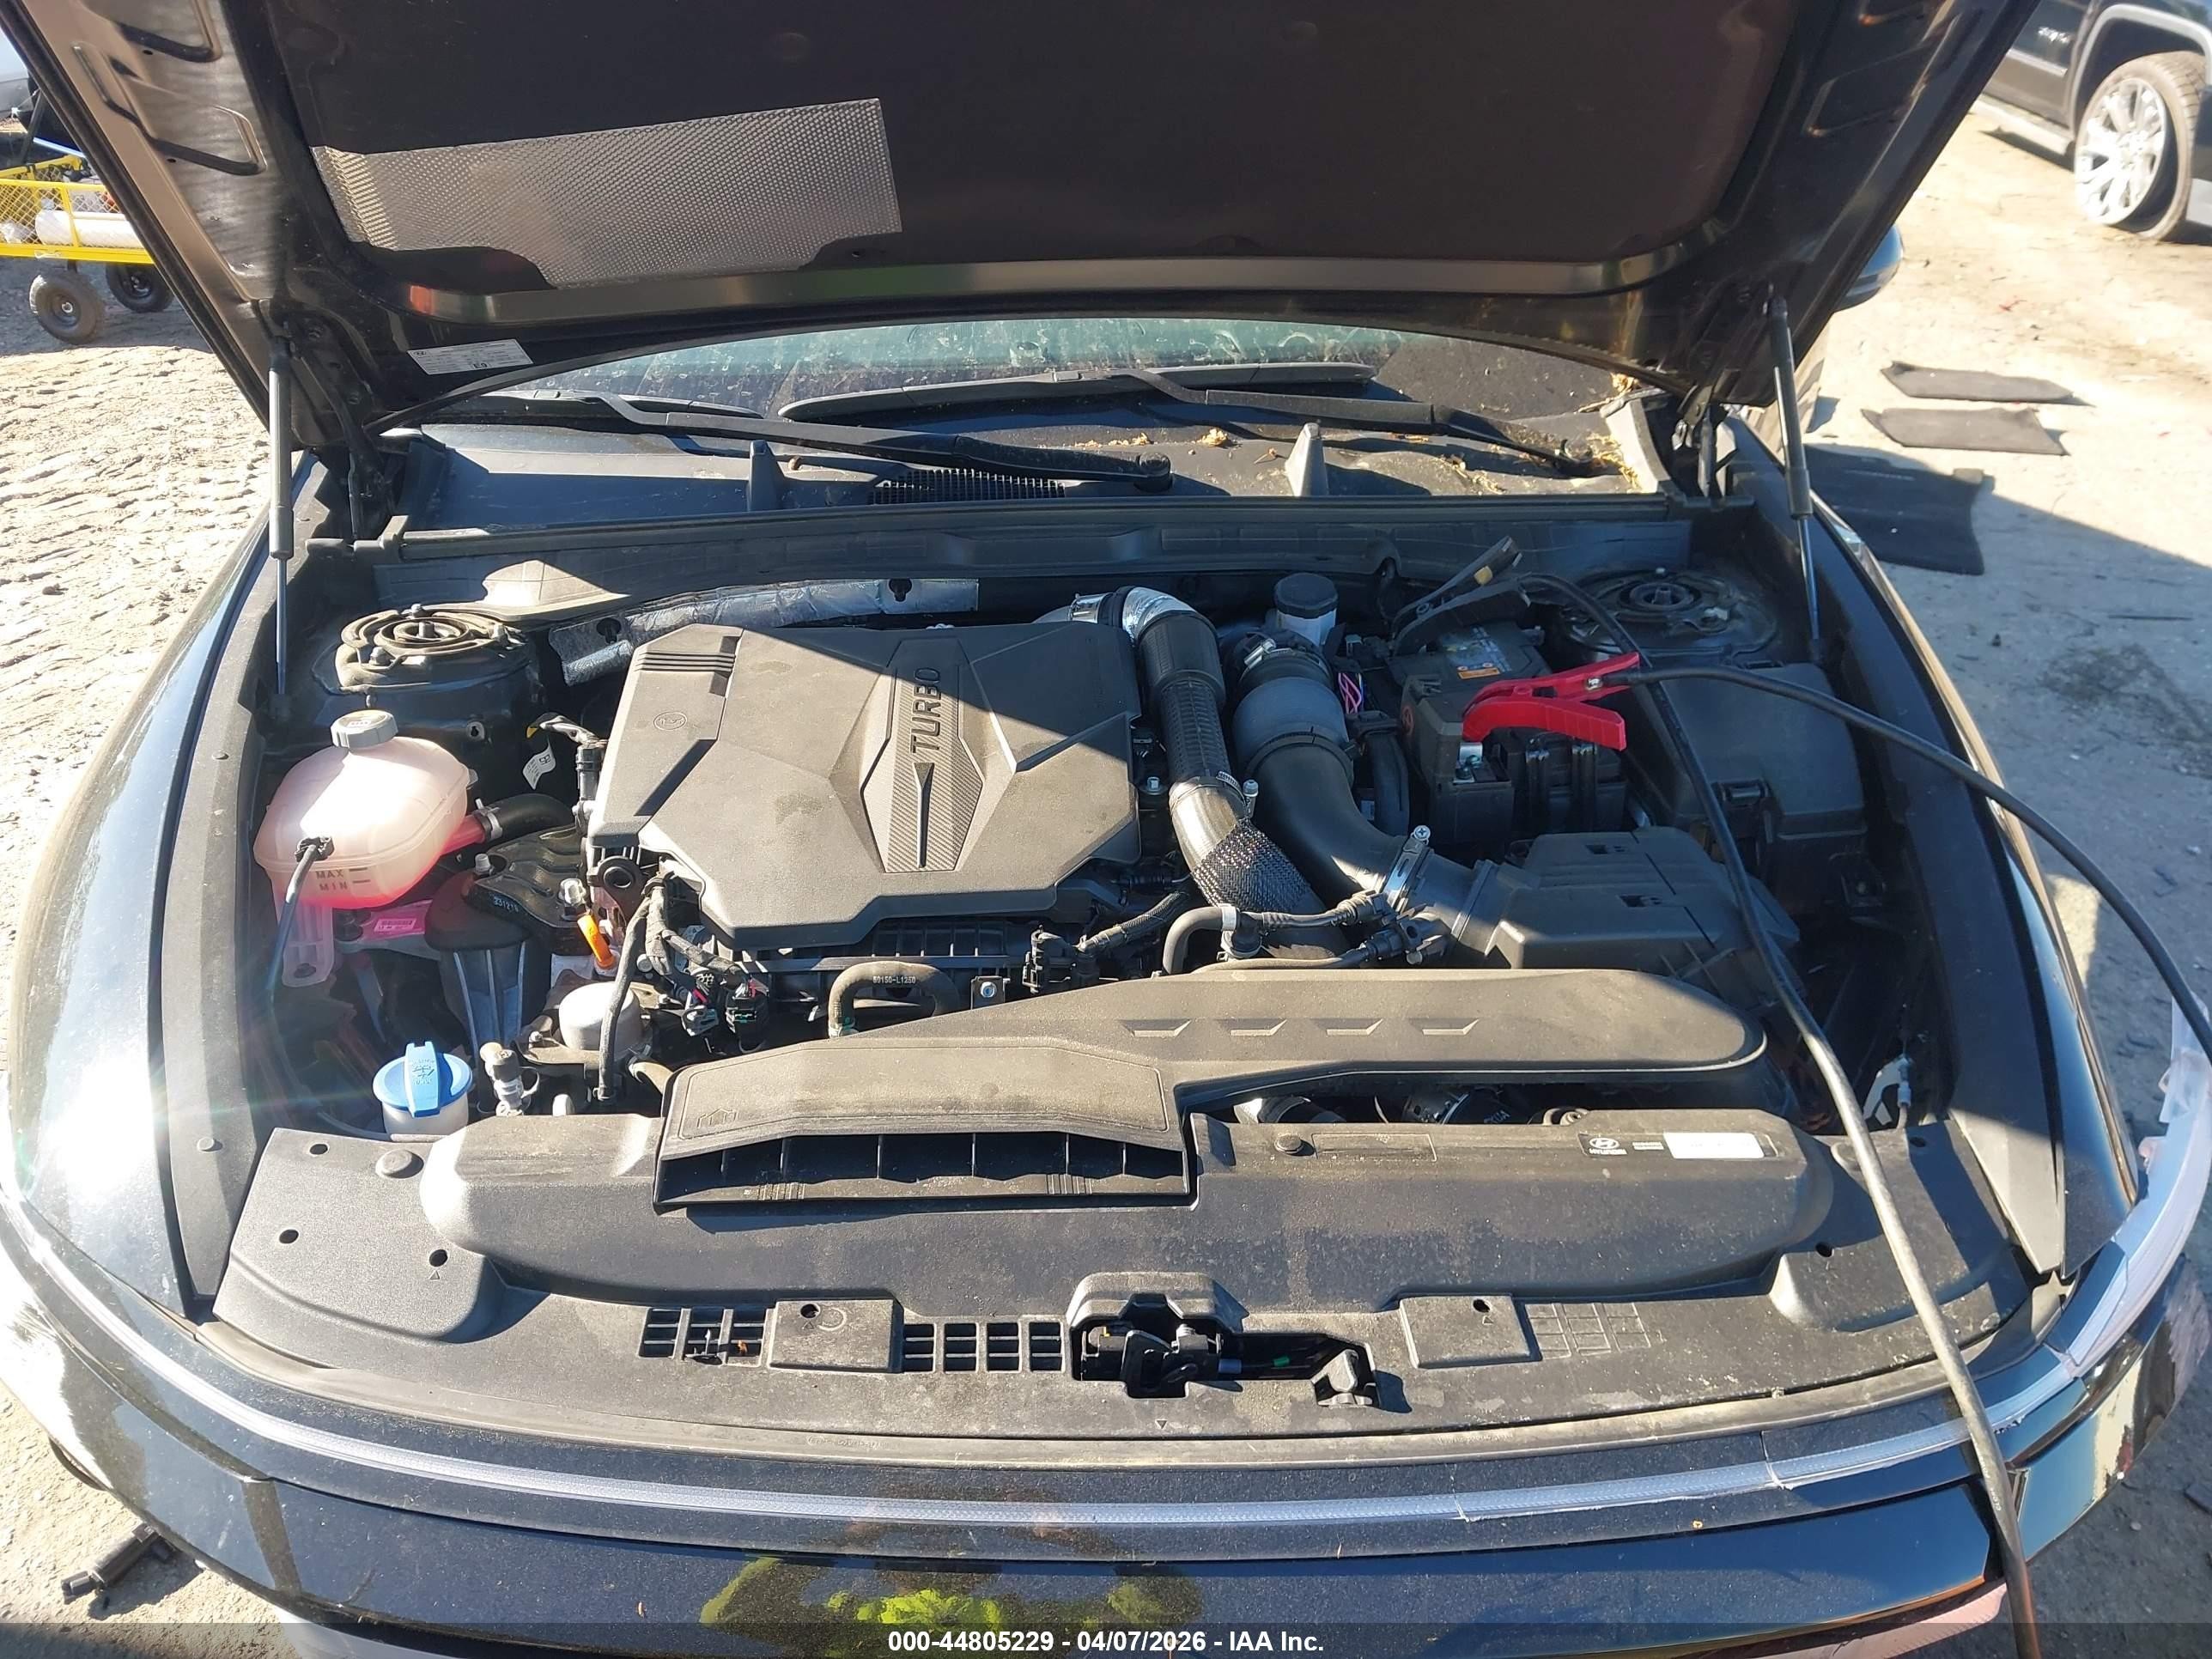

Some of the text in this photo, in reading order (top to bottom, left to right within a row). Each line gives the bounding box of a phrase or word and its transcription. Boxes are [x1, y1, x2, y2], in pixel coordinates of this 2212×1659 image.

[910, 667, 941, 753] TURBO
[315, 869, 344, 879] MAX
[319, 881, 348, 891] MIN
